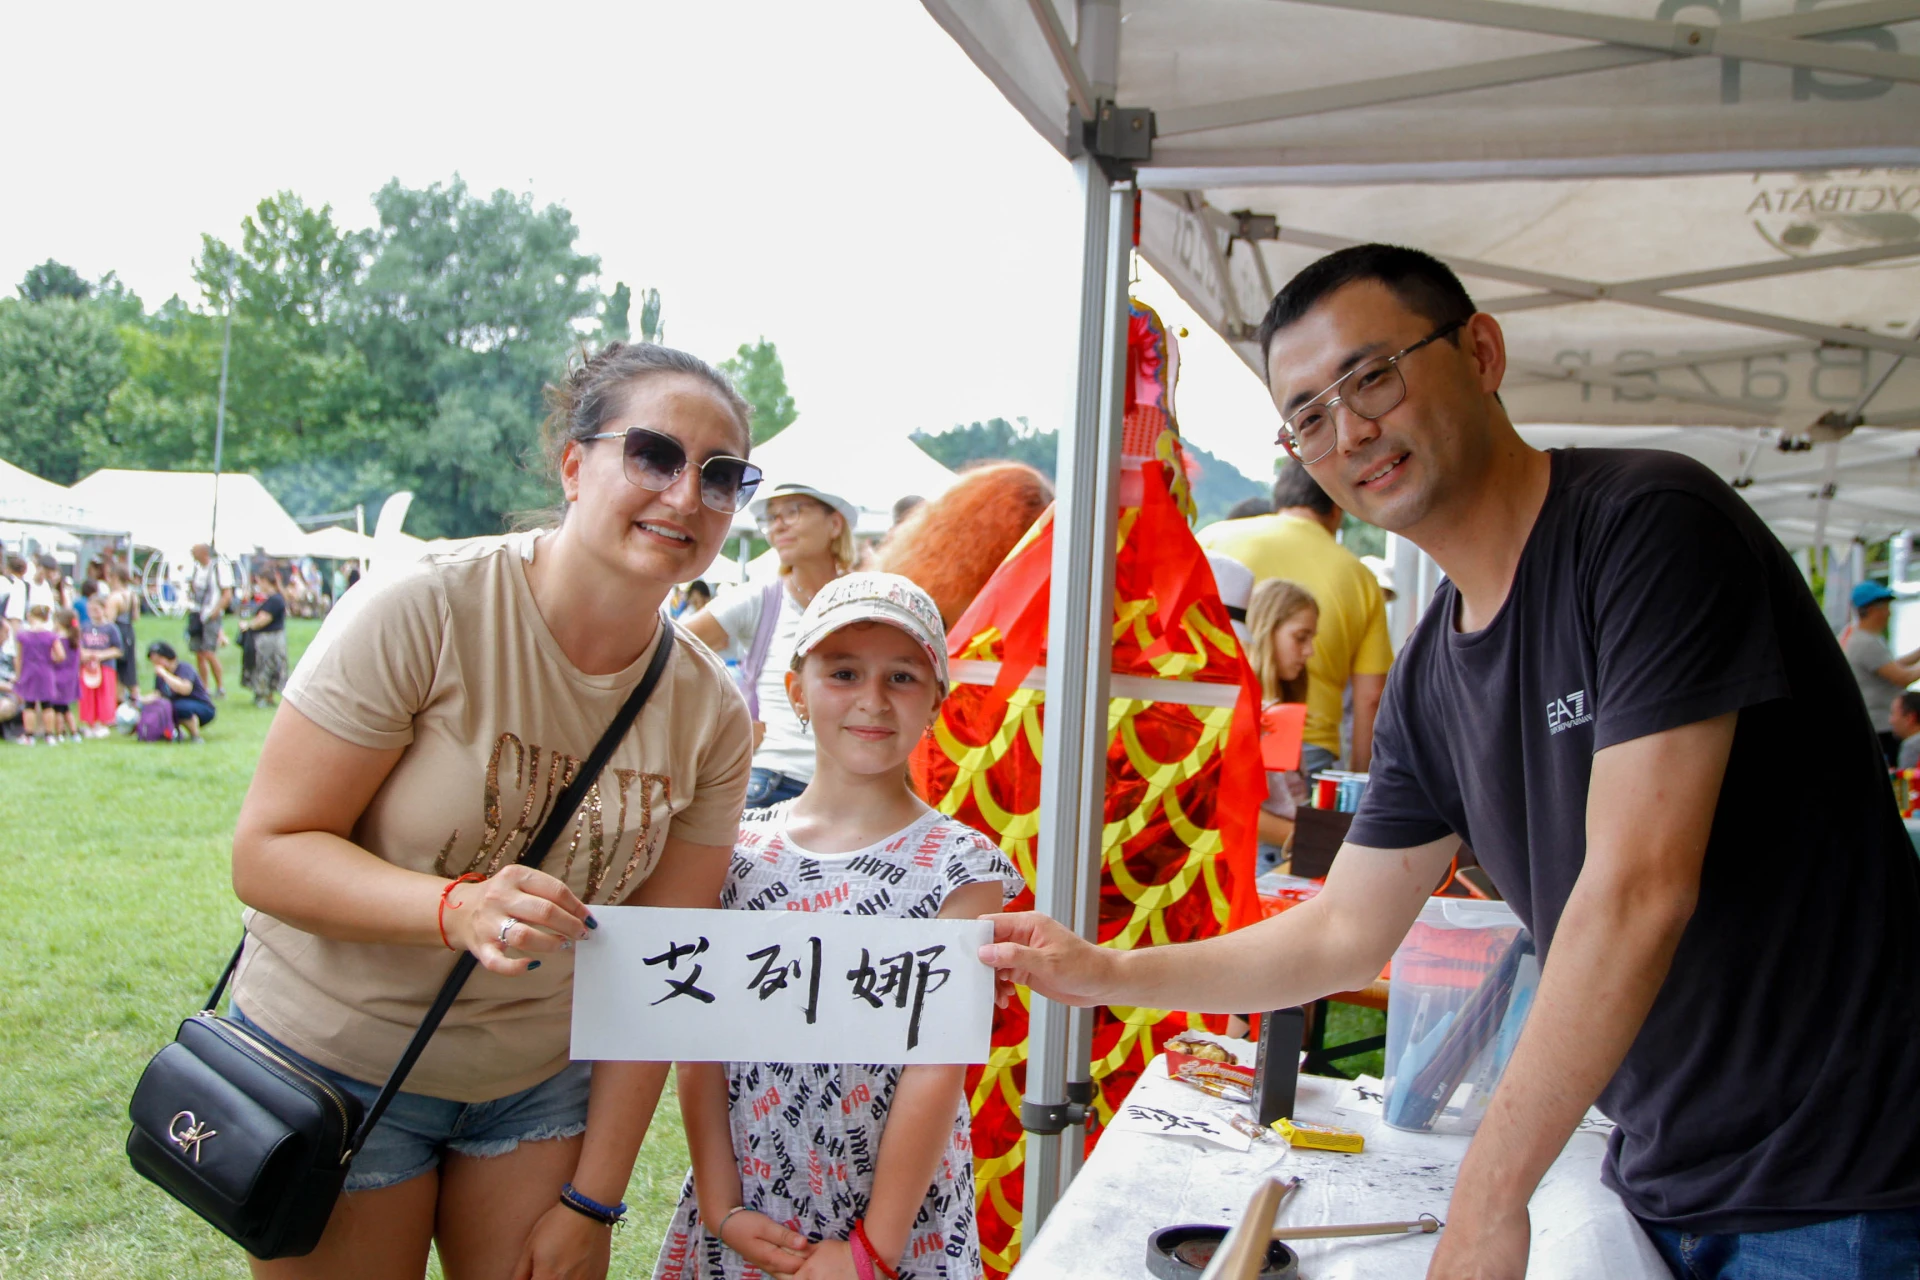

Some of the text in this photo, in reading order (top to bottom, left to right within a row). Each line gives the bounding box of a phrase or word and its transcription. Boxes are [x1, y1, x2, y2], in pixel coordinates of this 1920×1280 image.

[1546, 690, 1584, 728] EA7
[911, 826, 950, 868] BLAH!
[845, 854, 907, 885] BLAH!
[643, 936, 951, 1051] 艾列娜
